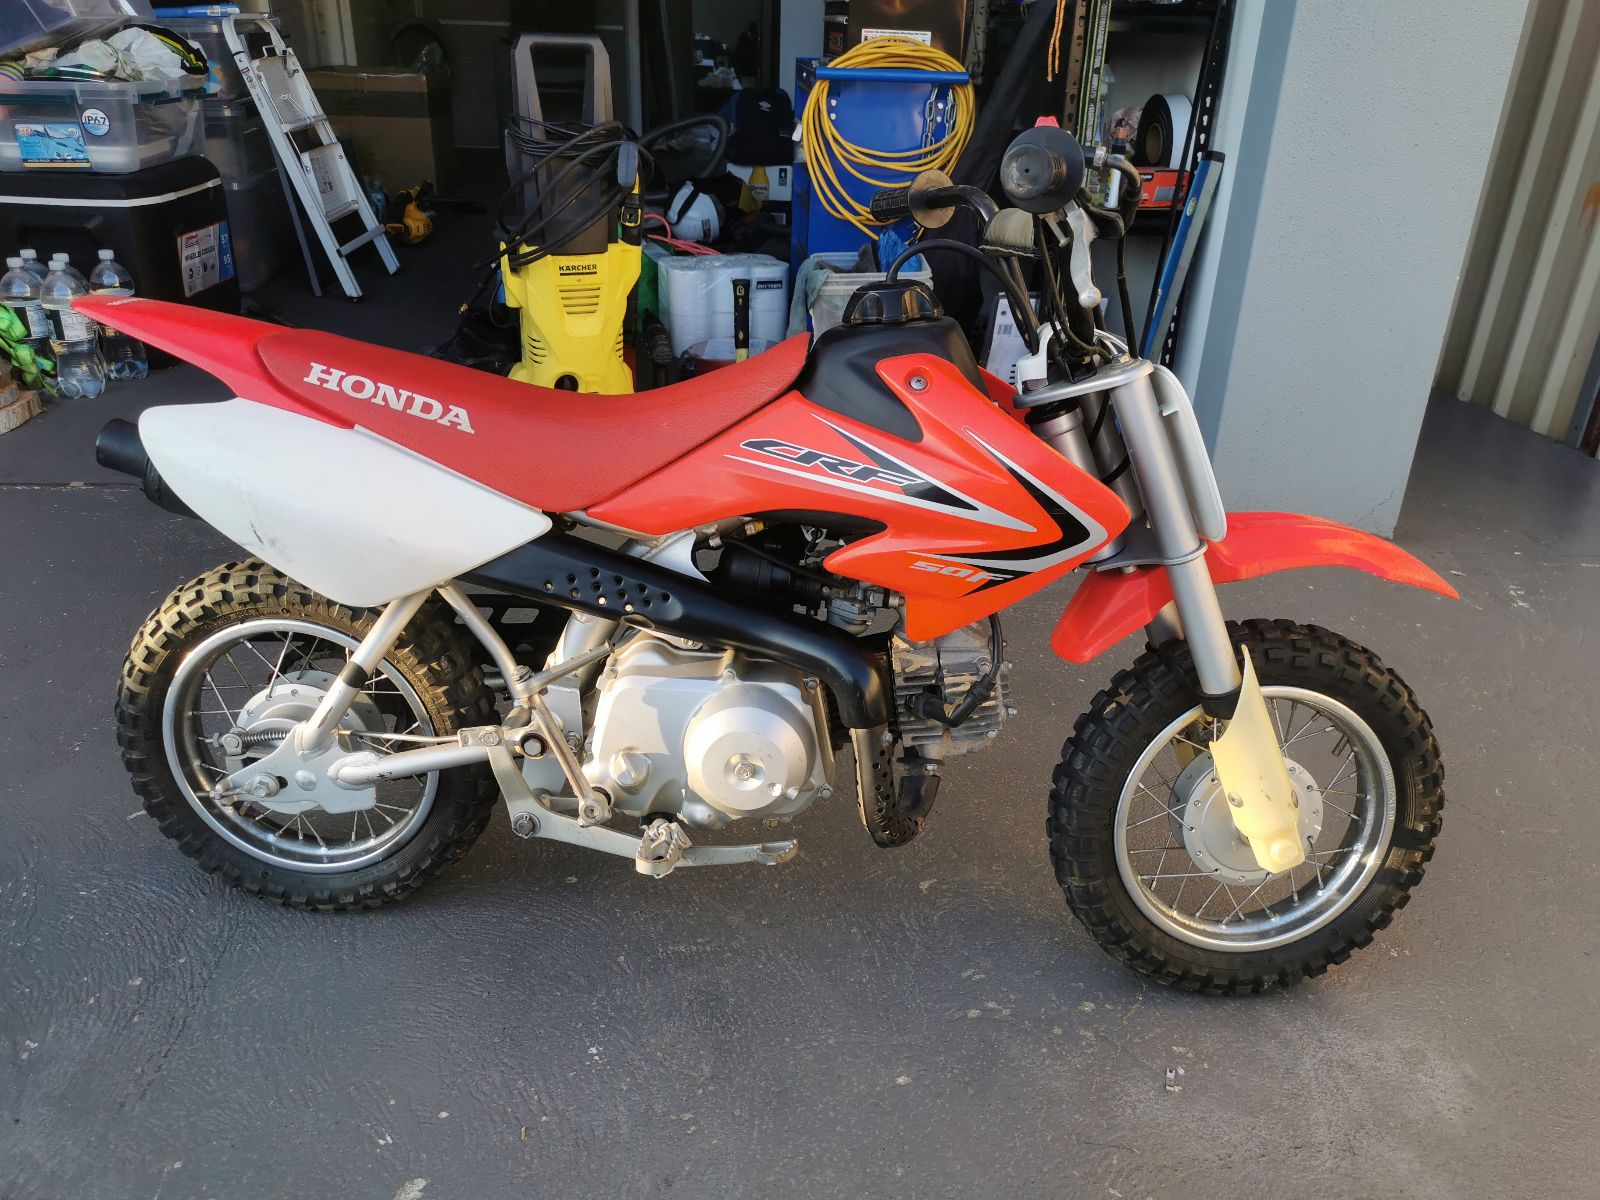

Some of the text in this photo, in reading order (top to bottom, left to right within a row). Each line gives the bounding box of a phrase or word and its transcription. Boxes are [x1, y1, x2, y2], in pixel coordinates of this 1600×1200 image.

[84, 115, 107, 126] IP67
[558, 264, 598, 272] KÄRCHER
[303, 361, 475, 434] HONDA
[739, 438, 928, 486] CRF
[909, 561, 1016, 583] 50F
